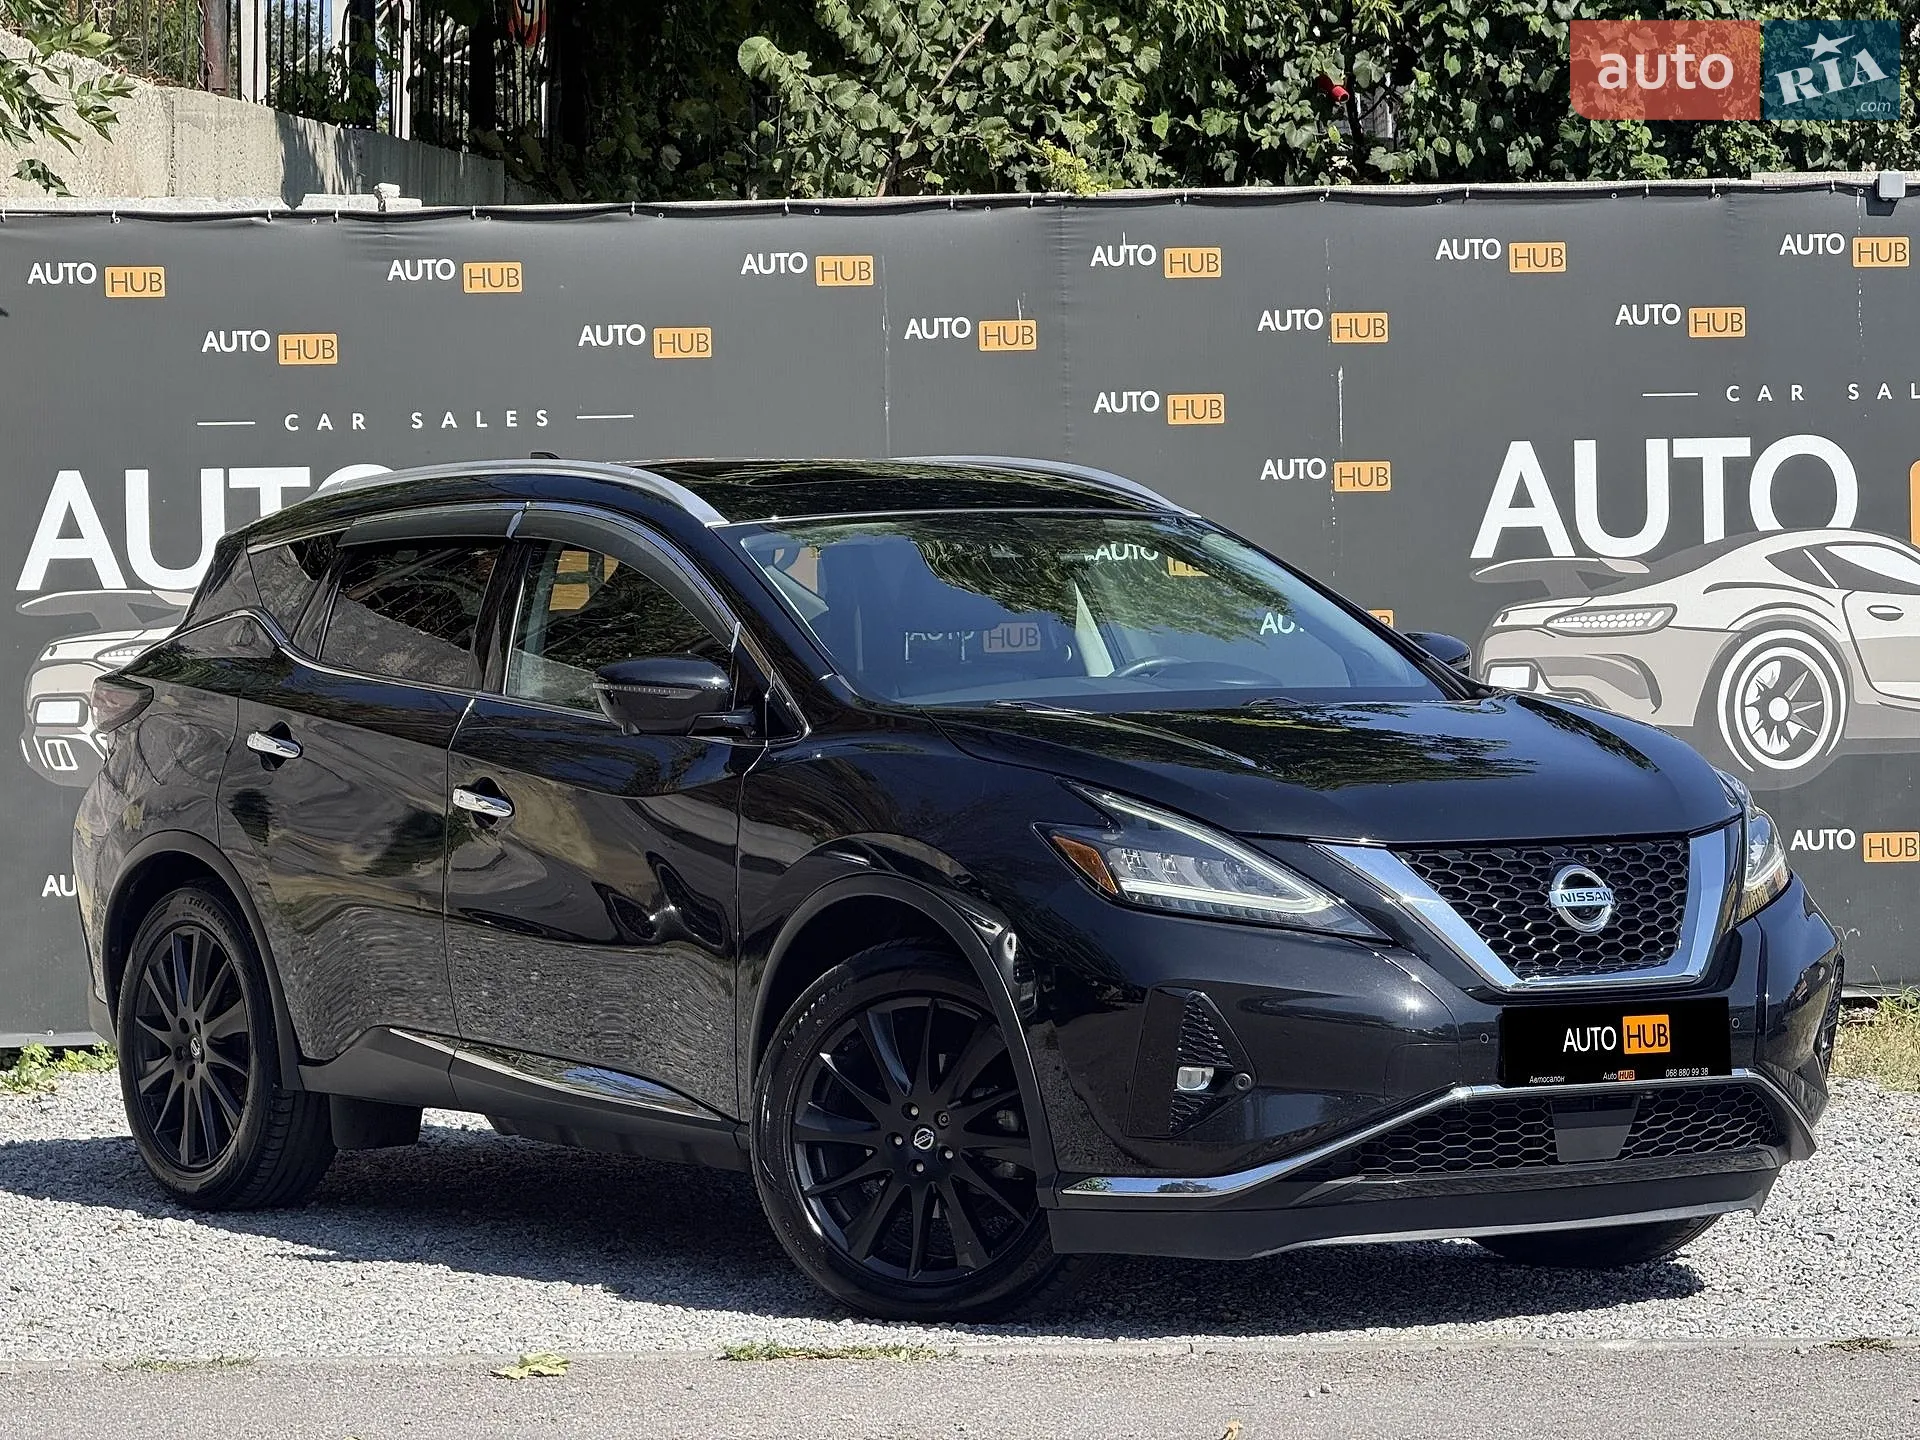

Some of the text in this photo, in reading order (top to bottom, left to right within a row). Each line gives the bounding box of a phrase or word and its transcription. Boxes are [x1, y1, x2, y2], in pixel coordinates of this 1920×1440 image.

[1090, 244, 1219, 274] AUTO HUB
[1436, 238, 1564, 268] AUTO HUB
[1780, 233, 1907, 263] AUTO HUB
[28, 263, 163, 293] AUTO HUB
[387, 259, 519, 289] AUTO HUB
[741, 252, 871, 282] AUTO HUB
[904, 317, 1034, 347] AUTO HUB
[1258, 309, 1386, 338] AUTO HUB
[1616, 304, 1743, 333] AUTO HUB
[202, 330, 335, 360] AUTO HUB
[578, 324, 709, 354] AUTO HUB
[1094, 391, 1222, 420] AUTO HUB
[1727, 384, 1804, 402] CAR
[284, 409, 549, 432] CAR SALES
[1261, 458, 1389, 487] AUTO HUB
[1470, 434, 1859, 559] AUTO
[16, 464, 396, 591] AUT
[988, 627, 1039, 649] HUB
[1790, 829, 1918, 858] AUTO HUB
[1560, 891, 1611, 903] NISSAN
[1563, 1023, 1669, 1052] AUTO HUB
[1602, 1072, 1617, 1081] Auto
